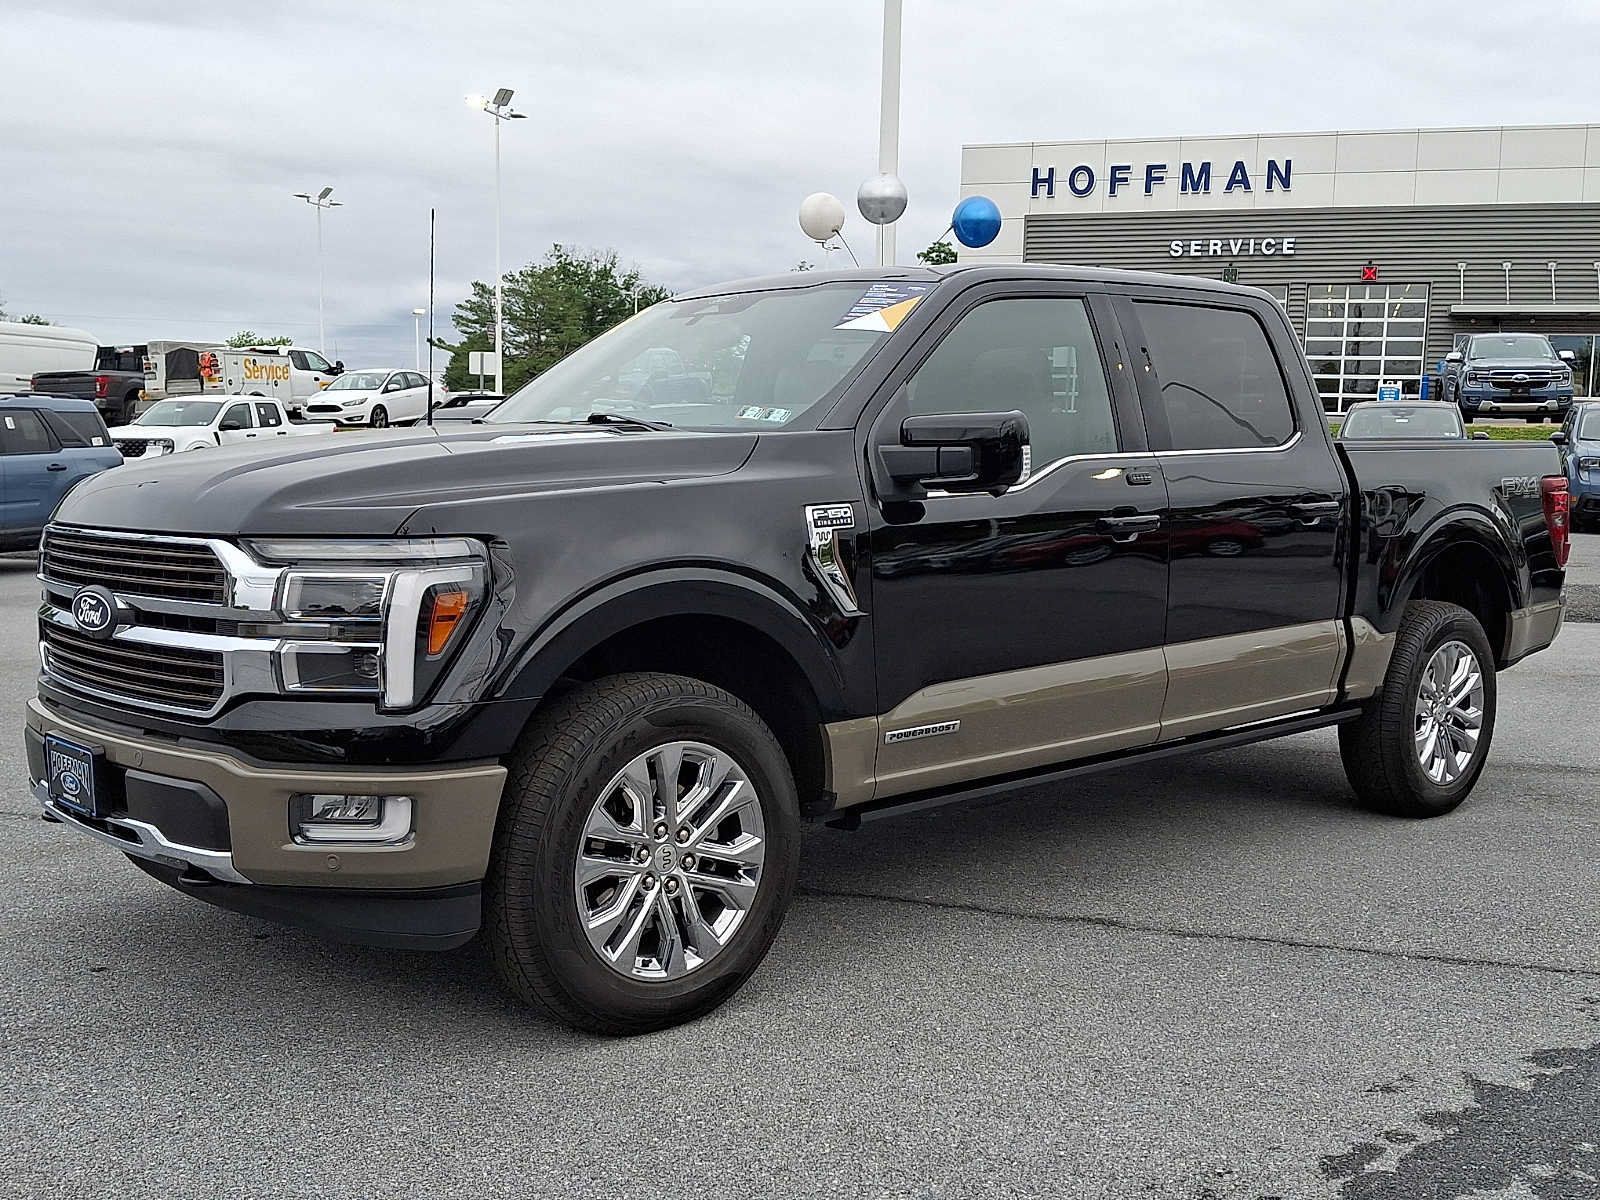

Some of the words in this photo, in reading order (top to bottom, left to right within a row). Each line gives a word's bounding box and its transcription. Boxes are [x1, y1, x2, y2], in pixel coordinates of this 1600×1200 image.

[1031, 160, 1292, 197] HOFFMAN
[1169, 237, 1296, 257] SERVICE
[243, 356, 290, 380] Service
[1501, 476, 1538, 499] FX4
[78, 596, 102, 625] Ford
[889, 722, 959, 741] POWERBOOST
